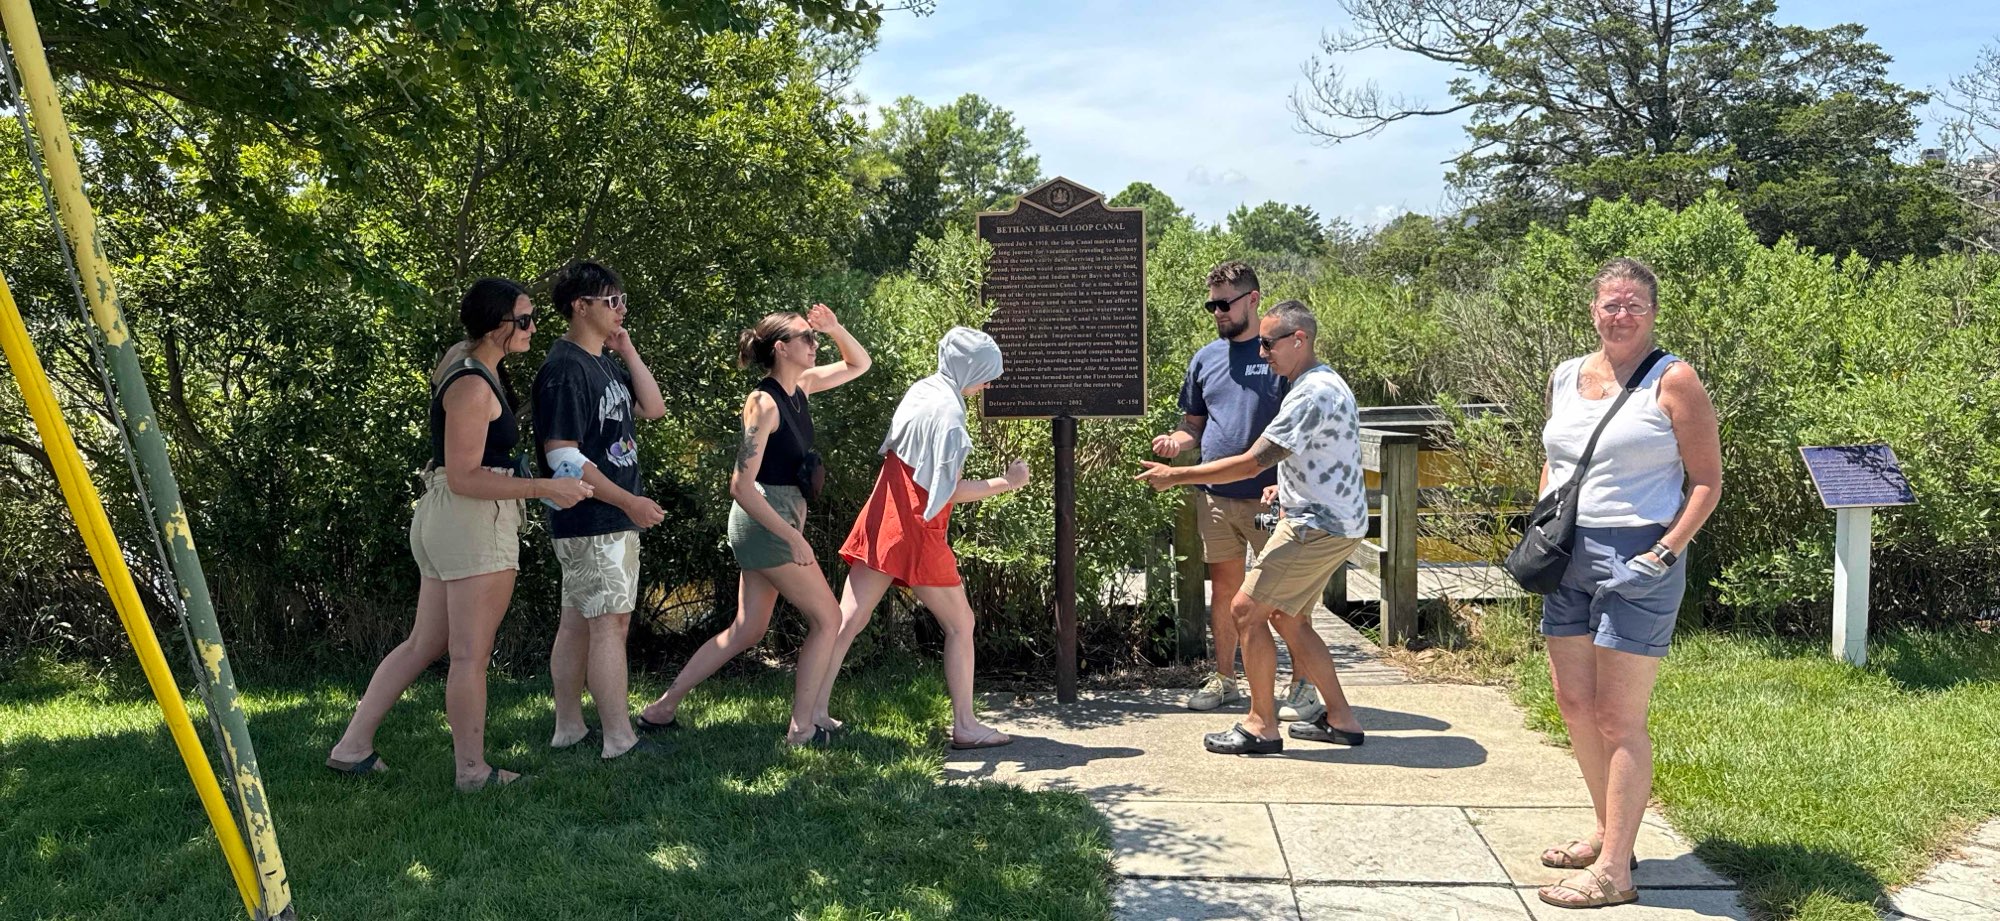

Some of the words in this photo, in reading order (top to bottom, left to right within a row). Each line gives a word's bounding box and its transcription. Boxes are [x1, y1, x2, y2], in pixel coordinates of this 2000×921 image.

[996, 225, 1037, 234] BETHANY
[1039, 224, 1068, 232] BEACH
[1016, 240, 1027, 248] July
[999, 249, 1010, 257] long
[1079, 247, 1104, 255] traveling
[1114, 246, 1137, 254] Bethany
[1069, 340, 1092, 348] property
[1088, 348, 1112, 356] complete
[1073, 356, 1089, 364] single
